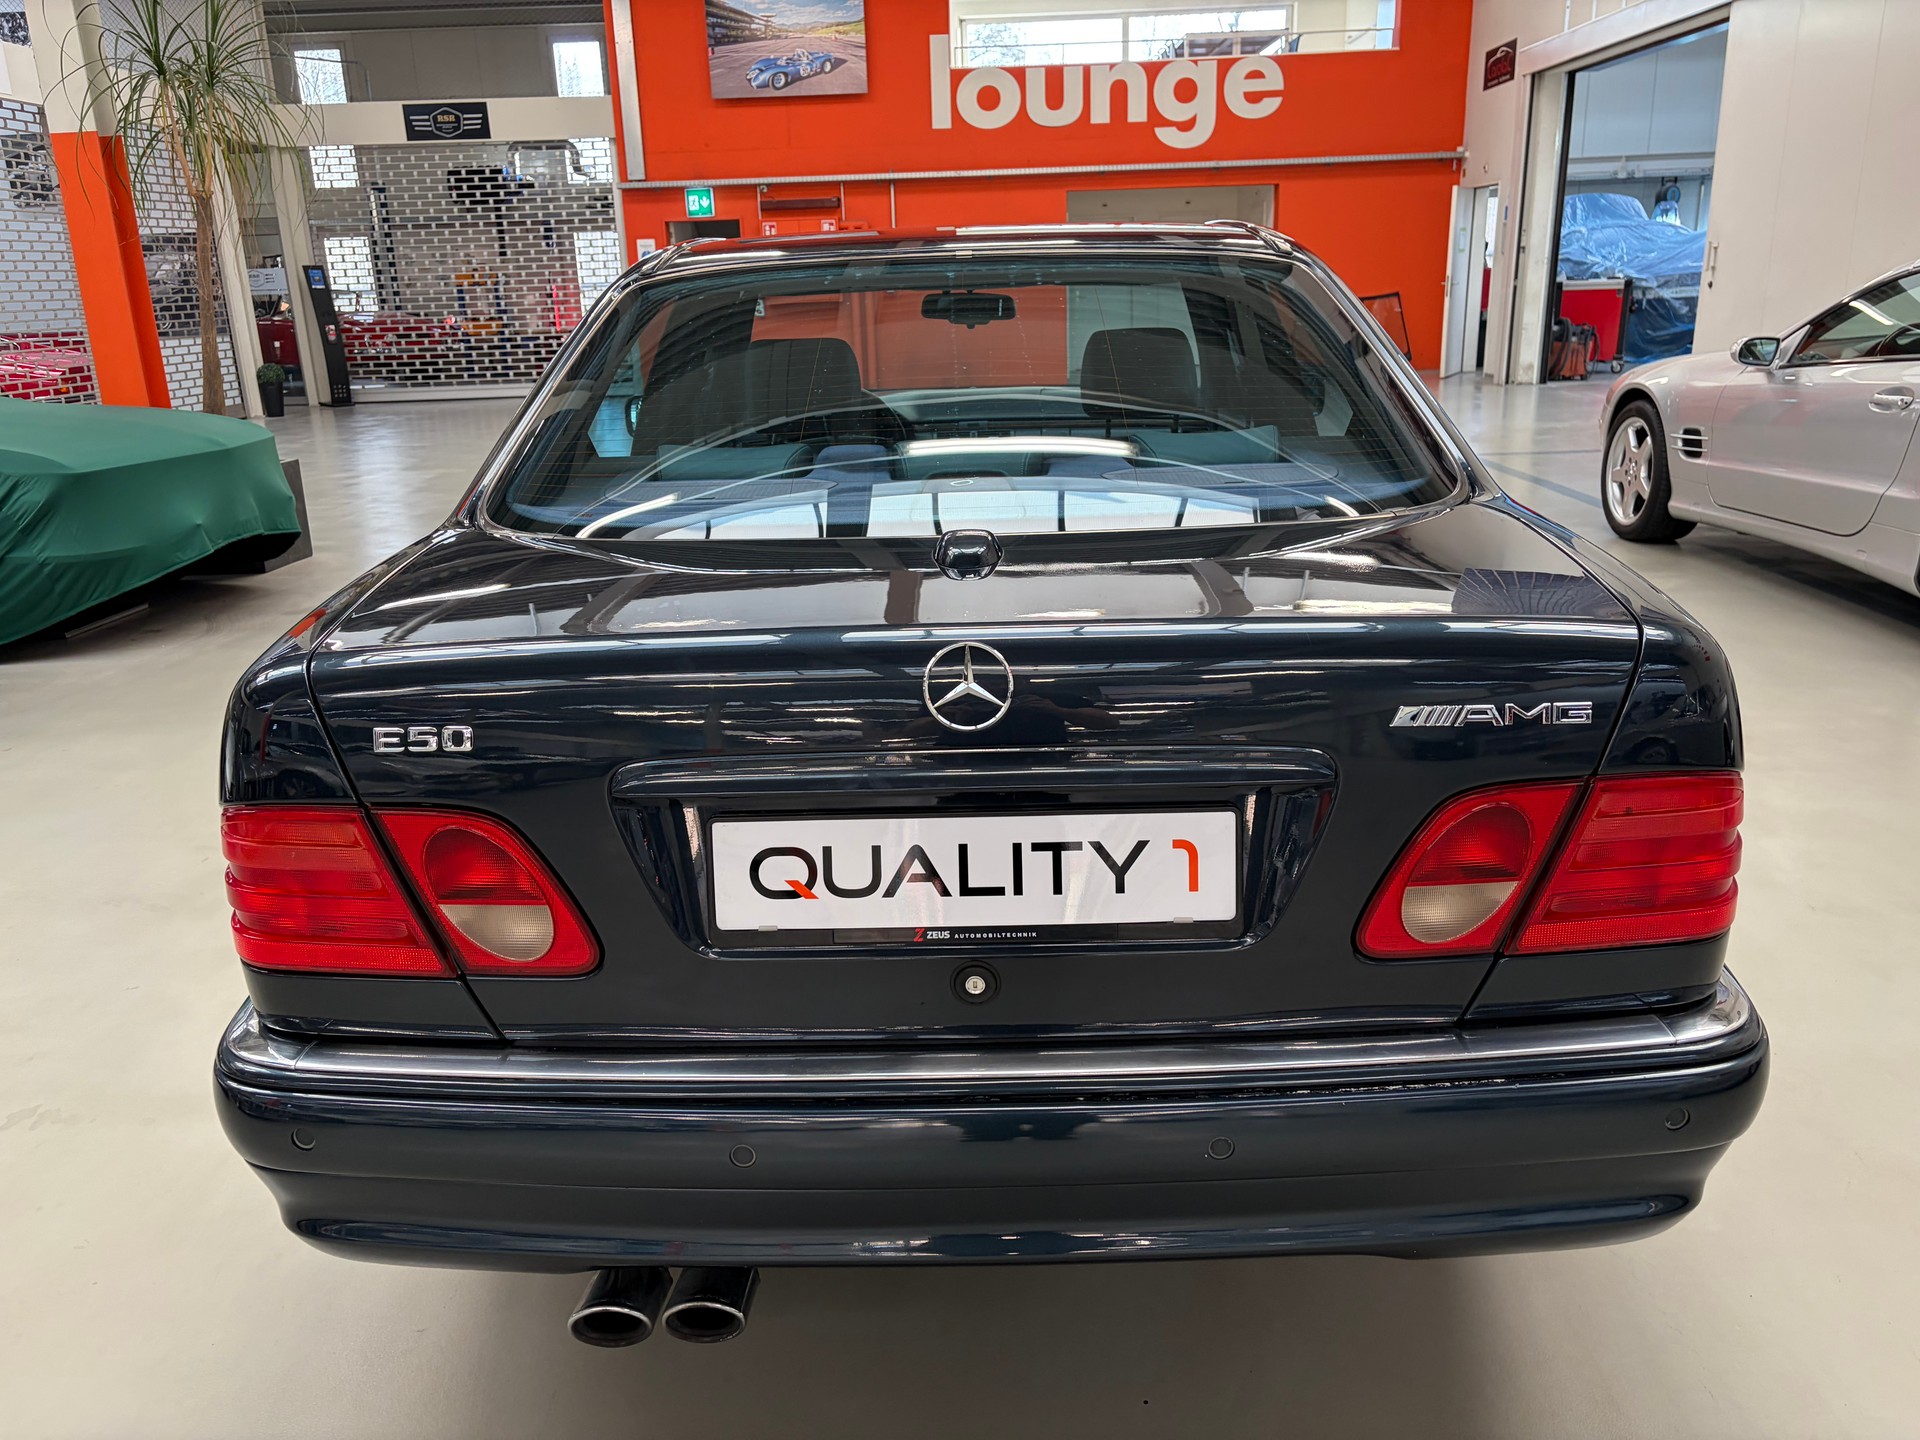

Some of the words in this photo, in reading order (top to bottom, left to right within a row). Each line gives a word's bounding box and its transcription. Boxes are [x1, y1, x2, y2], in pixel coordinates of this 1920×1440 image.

[929, 33, 1285, 149] lounge
[372, 725, 474, 753] E50
[748, 839, 1151, 900] QUALITY
[1171, 838, 1200, 893] 1
[926, 930, 951, 940] ZEUS
[954, 931, 1038, 940] AUTOMOBILTECHNIK
